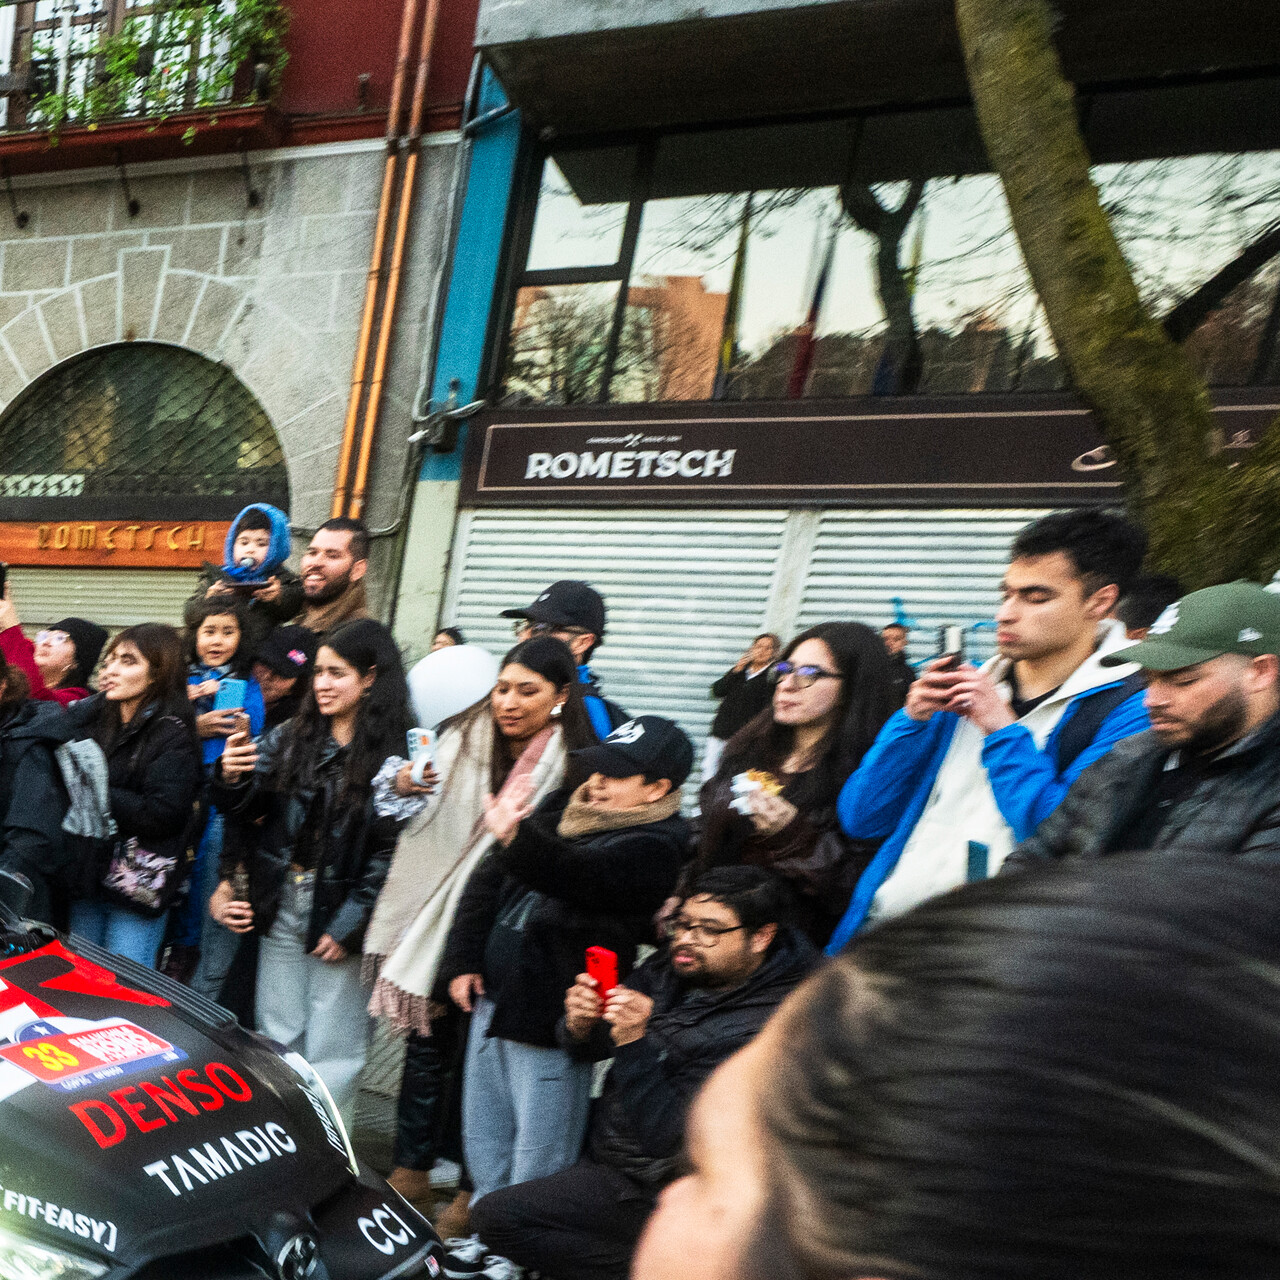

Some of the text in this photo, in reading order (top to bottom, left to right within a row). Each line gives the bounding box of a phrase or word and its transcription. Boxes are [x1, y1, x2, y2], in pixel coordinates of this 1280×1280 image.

[524, 449, 737, 480] ROMETSCH
[22, 1042, 80, 1072] 33
[68, 1063, 255, 1149] DENSO
[143, 1121, 298, 1197] TAMADIC
[357, 1202, 417, 1256] CCI
